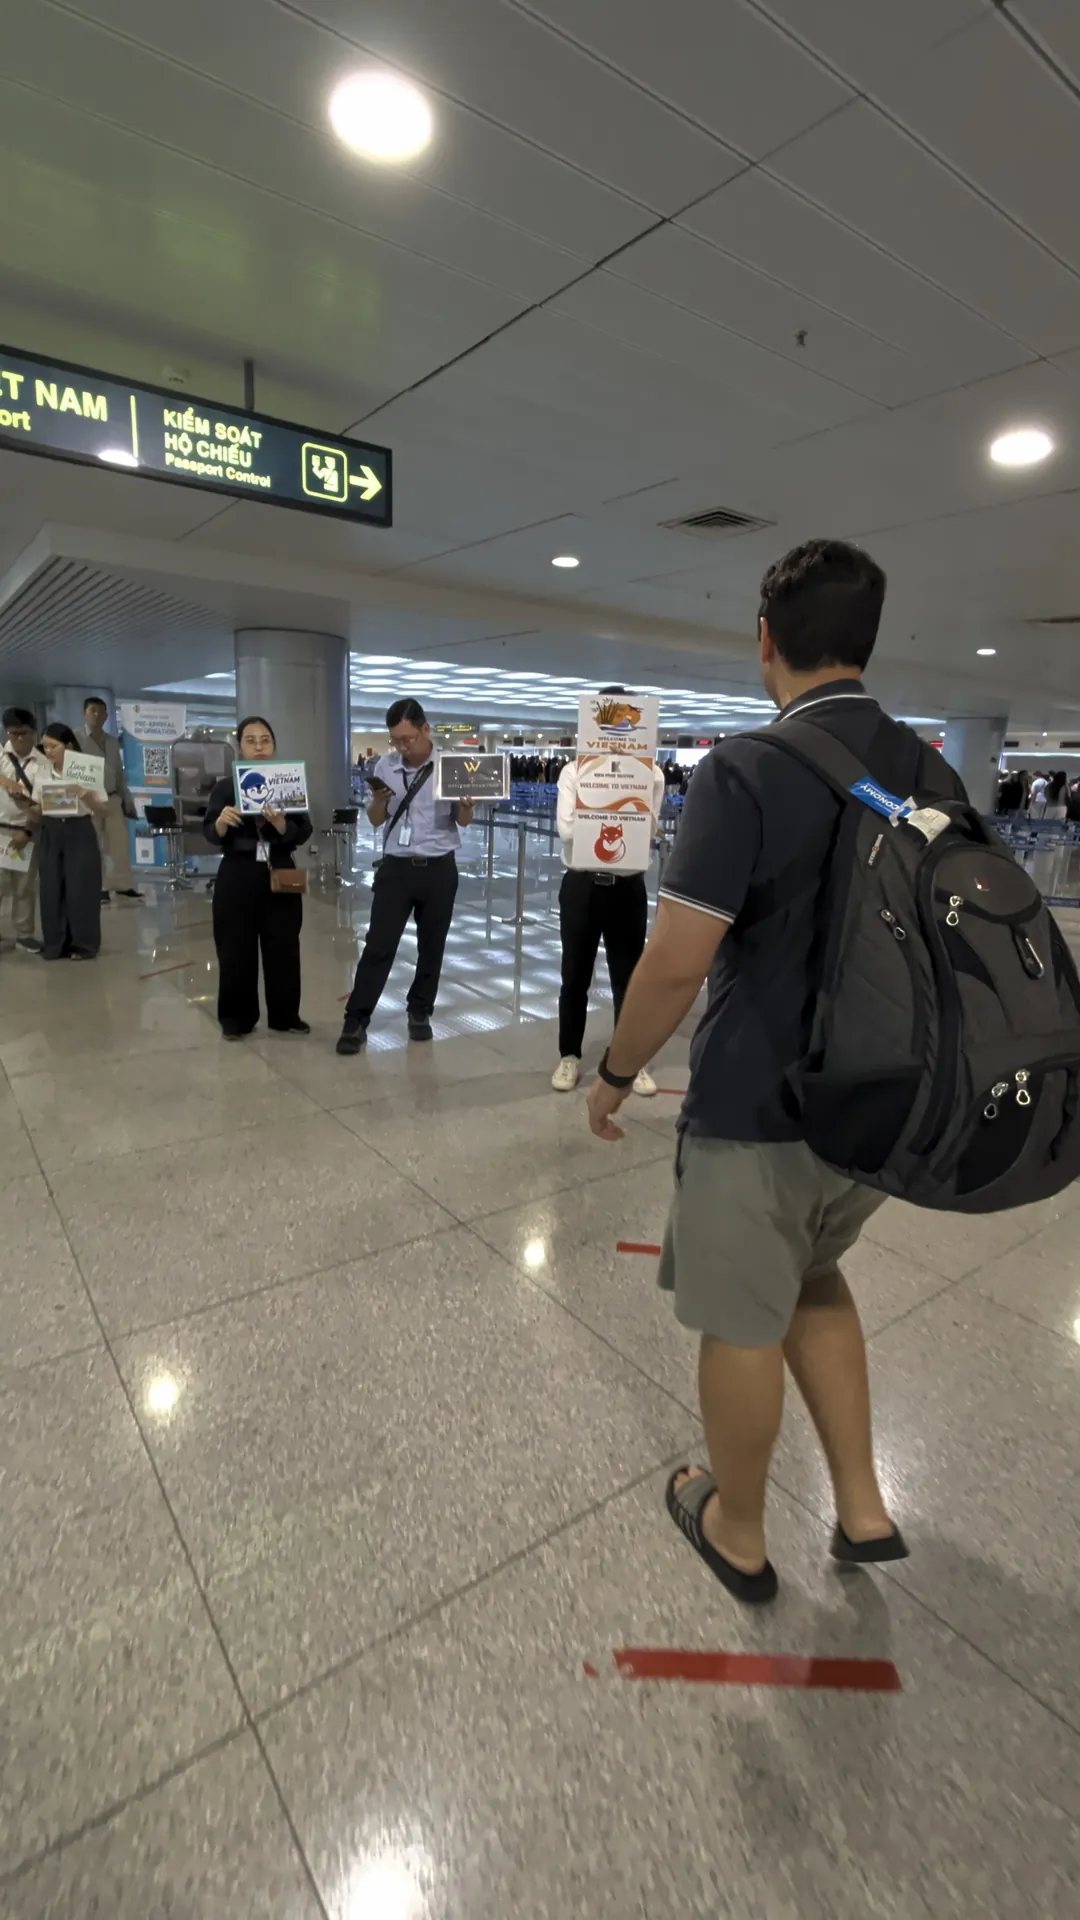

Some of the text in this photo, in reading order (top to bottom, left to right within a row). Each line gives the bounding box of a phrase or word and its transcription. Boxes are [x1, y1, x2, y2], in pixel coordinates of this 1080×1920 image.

[35, 379, 108, 422] NAM
[163, 407, 262, 449] KIỂM SOÁT
[164, 432, 252, 468] HỘ CHIẾU
[165, 452, 271, 488] Passport Control
[268, 776, 301, 786] VIETNAM
